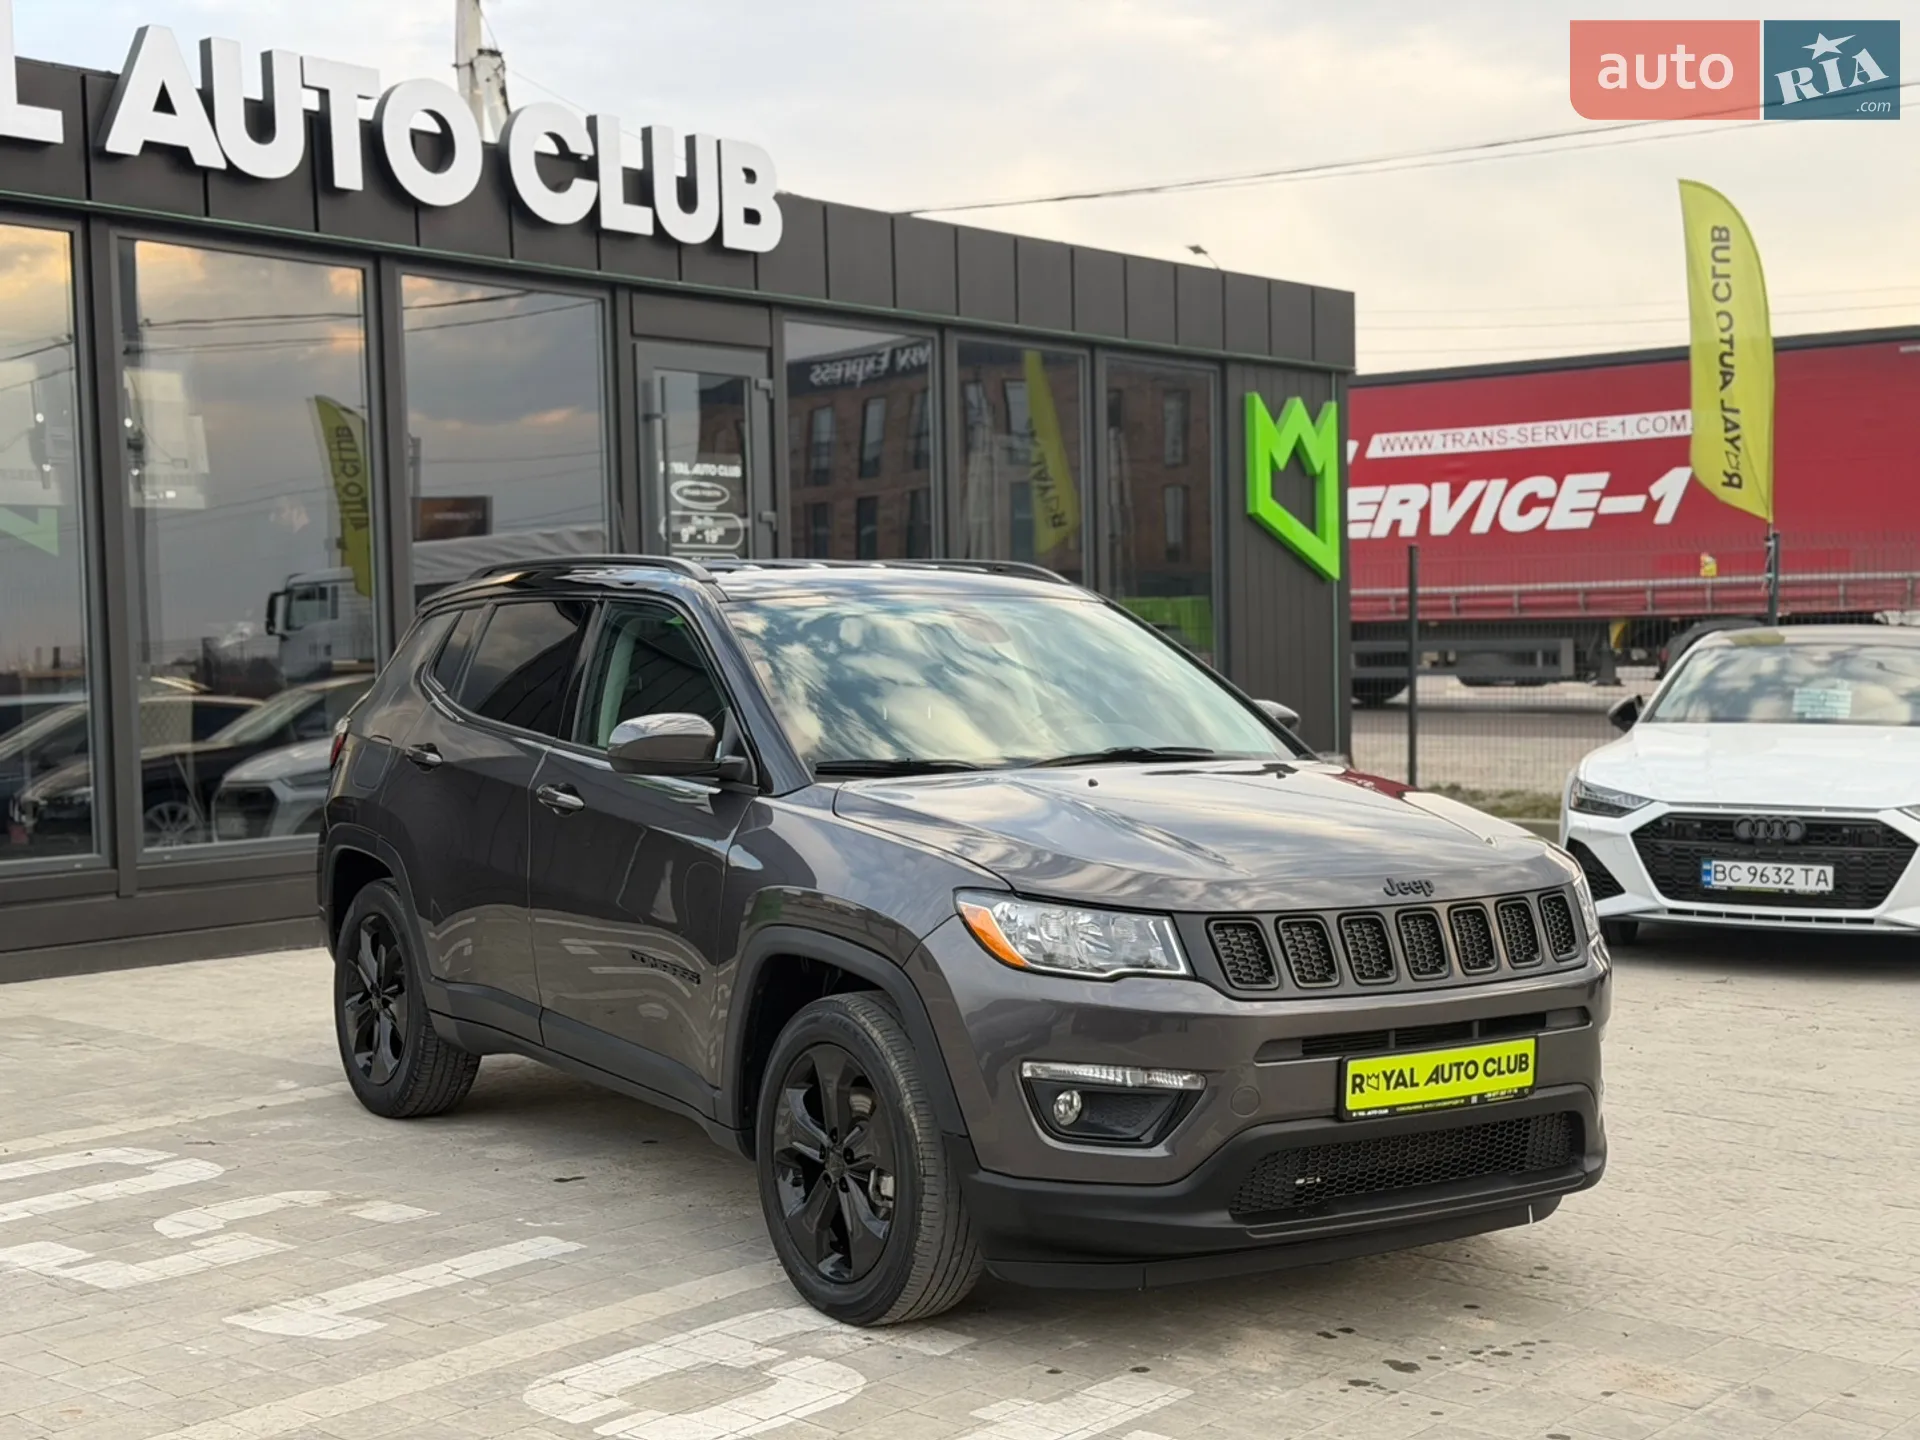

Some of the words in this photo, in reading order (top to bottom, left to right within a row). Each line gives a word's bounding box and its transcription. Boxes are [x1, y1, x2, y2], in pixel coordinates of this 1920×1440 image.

[105, 24, 484, 206] AUTO
[504, 102, 783, 253] CLUB
[1347, 467, 1693, 539] ERVICE-1
[1383, 877, 1435, 897] Jeep
[1713, 863, 1742, 882] BC
[1747, 865, 1795, 885] 9632
[1800, 868, 1829, 887] TA
[1424, 1059, 1479, 1087] AUTO
[1483, 1052, 1529, 1078] CLUB
